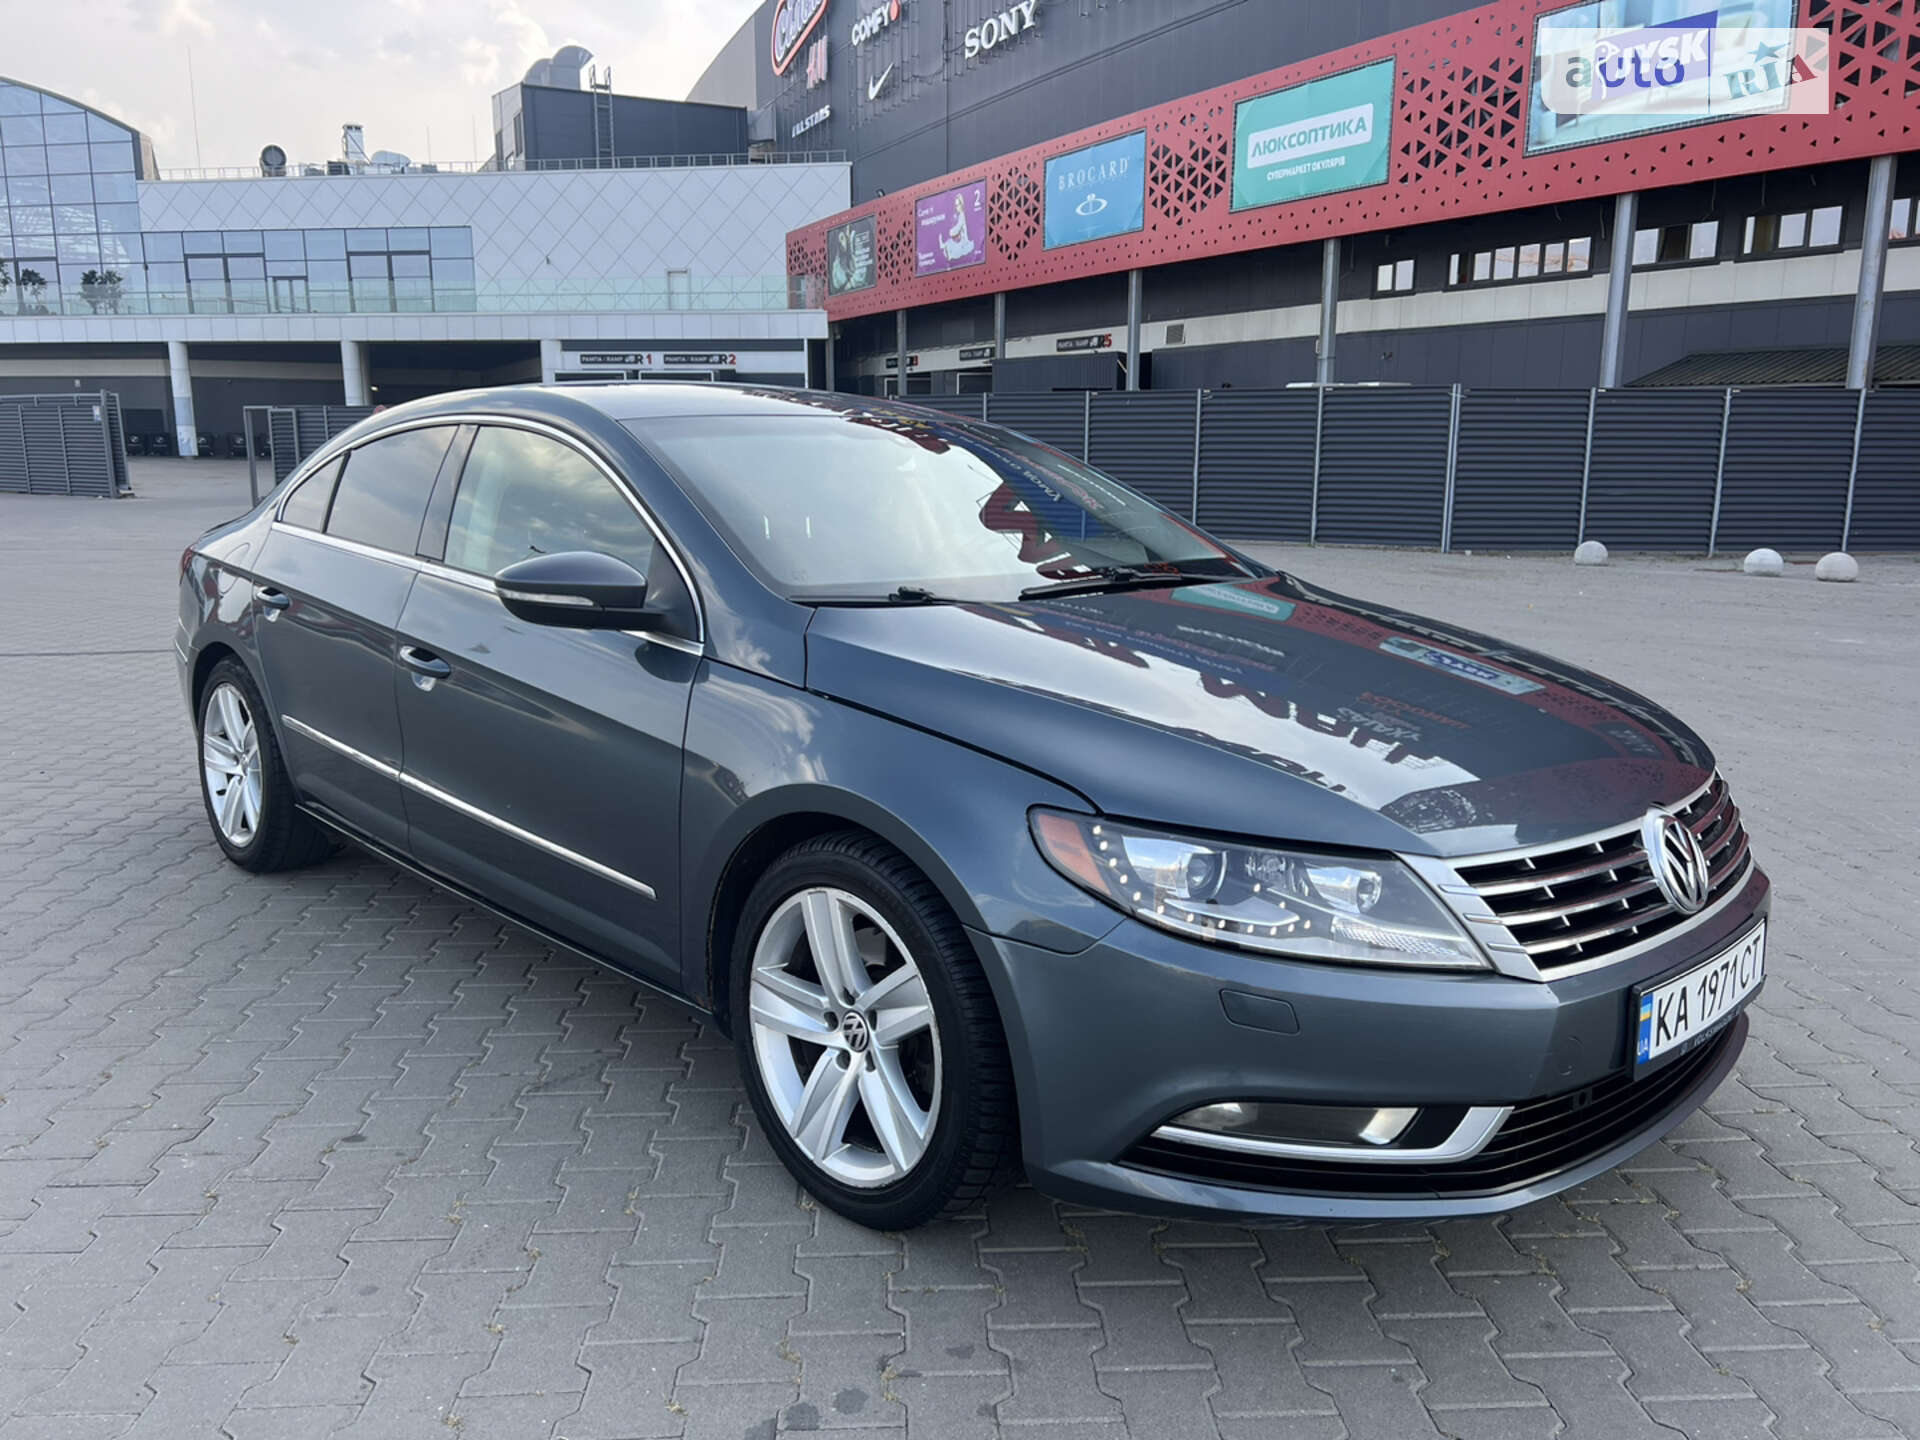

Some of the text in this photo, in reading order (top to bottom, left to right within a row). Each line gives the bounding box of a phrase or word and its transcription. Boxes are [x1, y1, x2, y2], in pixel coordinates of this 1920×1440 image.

[851, 2, 891, 46] COMFY
[964, 0, 1039, 59] SONY
[1615, 30, 1709, 80] JYSK
[1251, 116, 1367, 158] ЛЮКСОПТИКА
[1058, 158, 1129, 190] BROCARD
[1656, 985, 1689, 1048] KA
[1697, 953, 1739, 1022] 1971
[1740, 934, 1761, 989] CT
